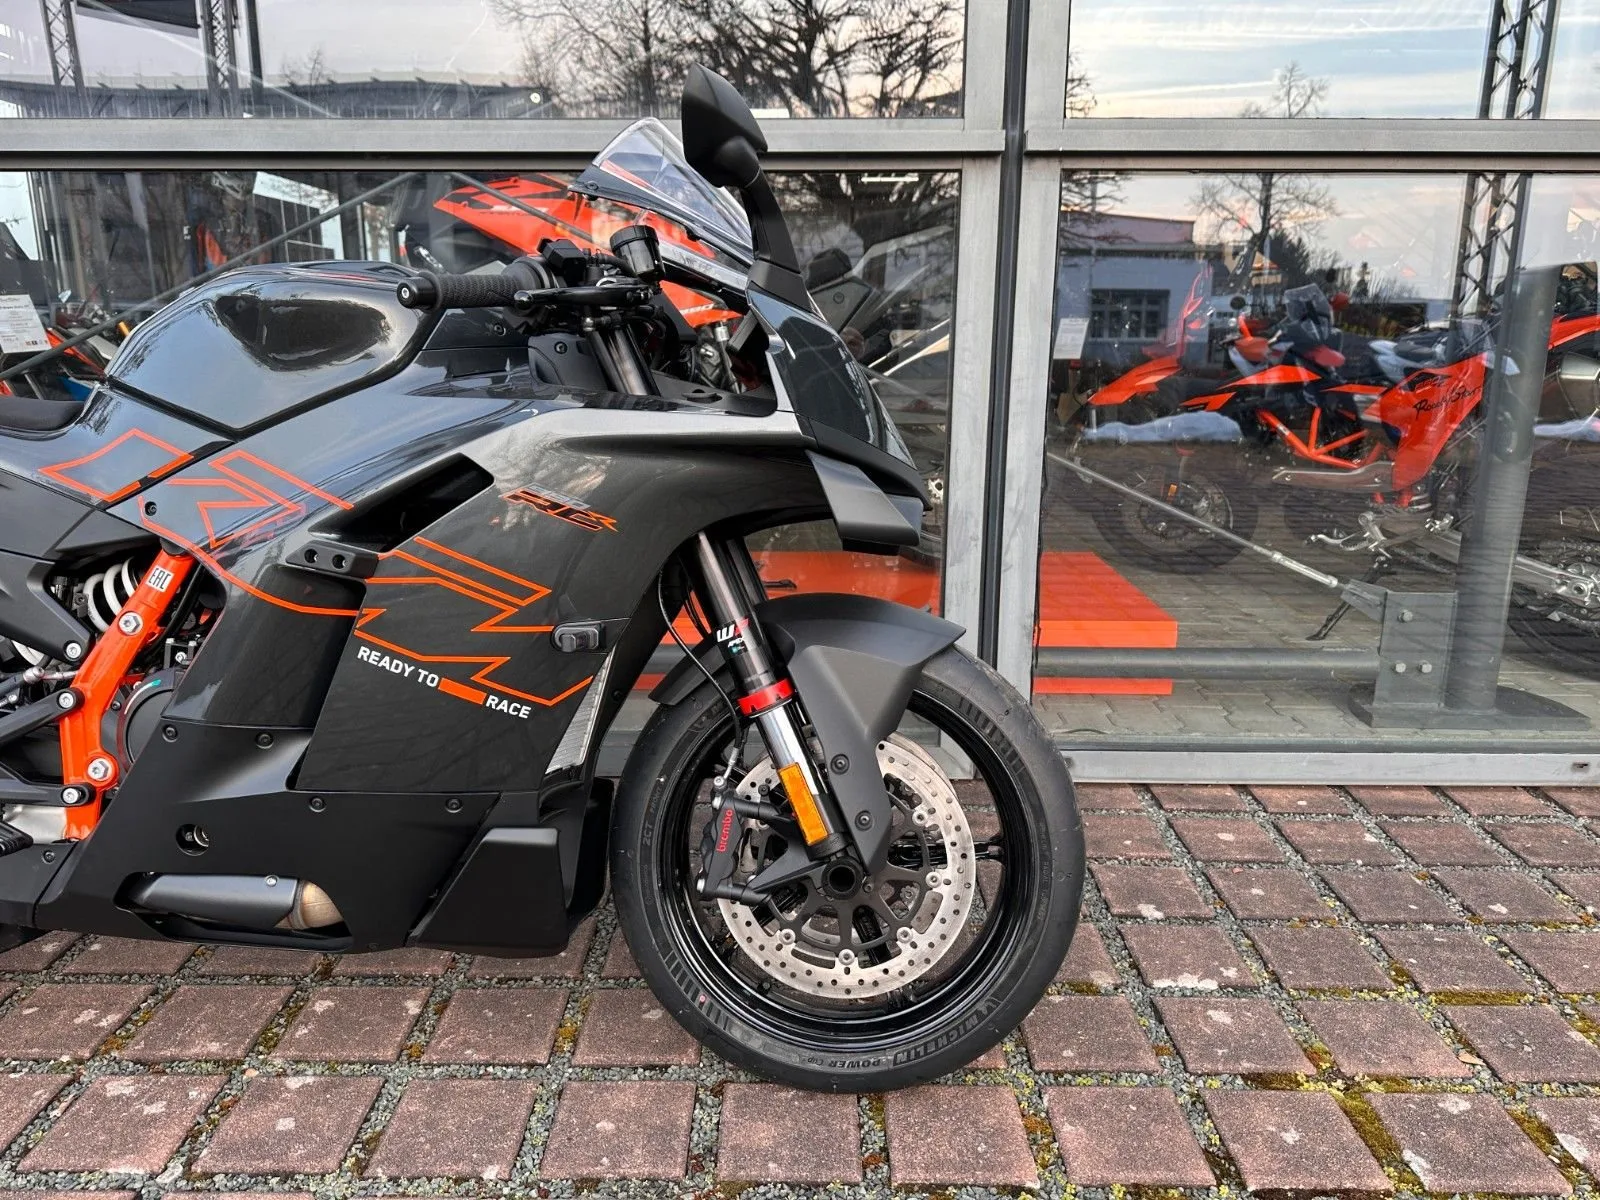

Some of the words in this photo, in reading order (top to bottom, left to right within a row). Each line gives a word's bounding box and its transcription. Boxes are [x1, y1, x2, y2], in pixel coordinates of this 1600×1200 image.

[148, 567, 172, 590] EAC
[357, 645, 415, 677] READY
[418, 668, 439, 687] TO
[485, 694, 532, 719] RACE
[716, 808, 734, 853] brembo
[895, 1014, 979, 1065] MICHELIN
[829, 1058, 881, 1069] POWER
